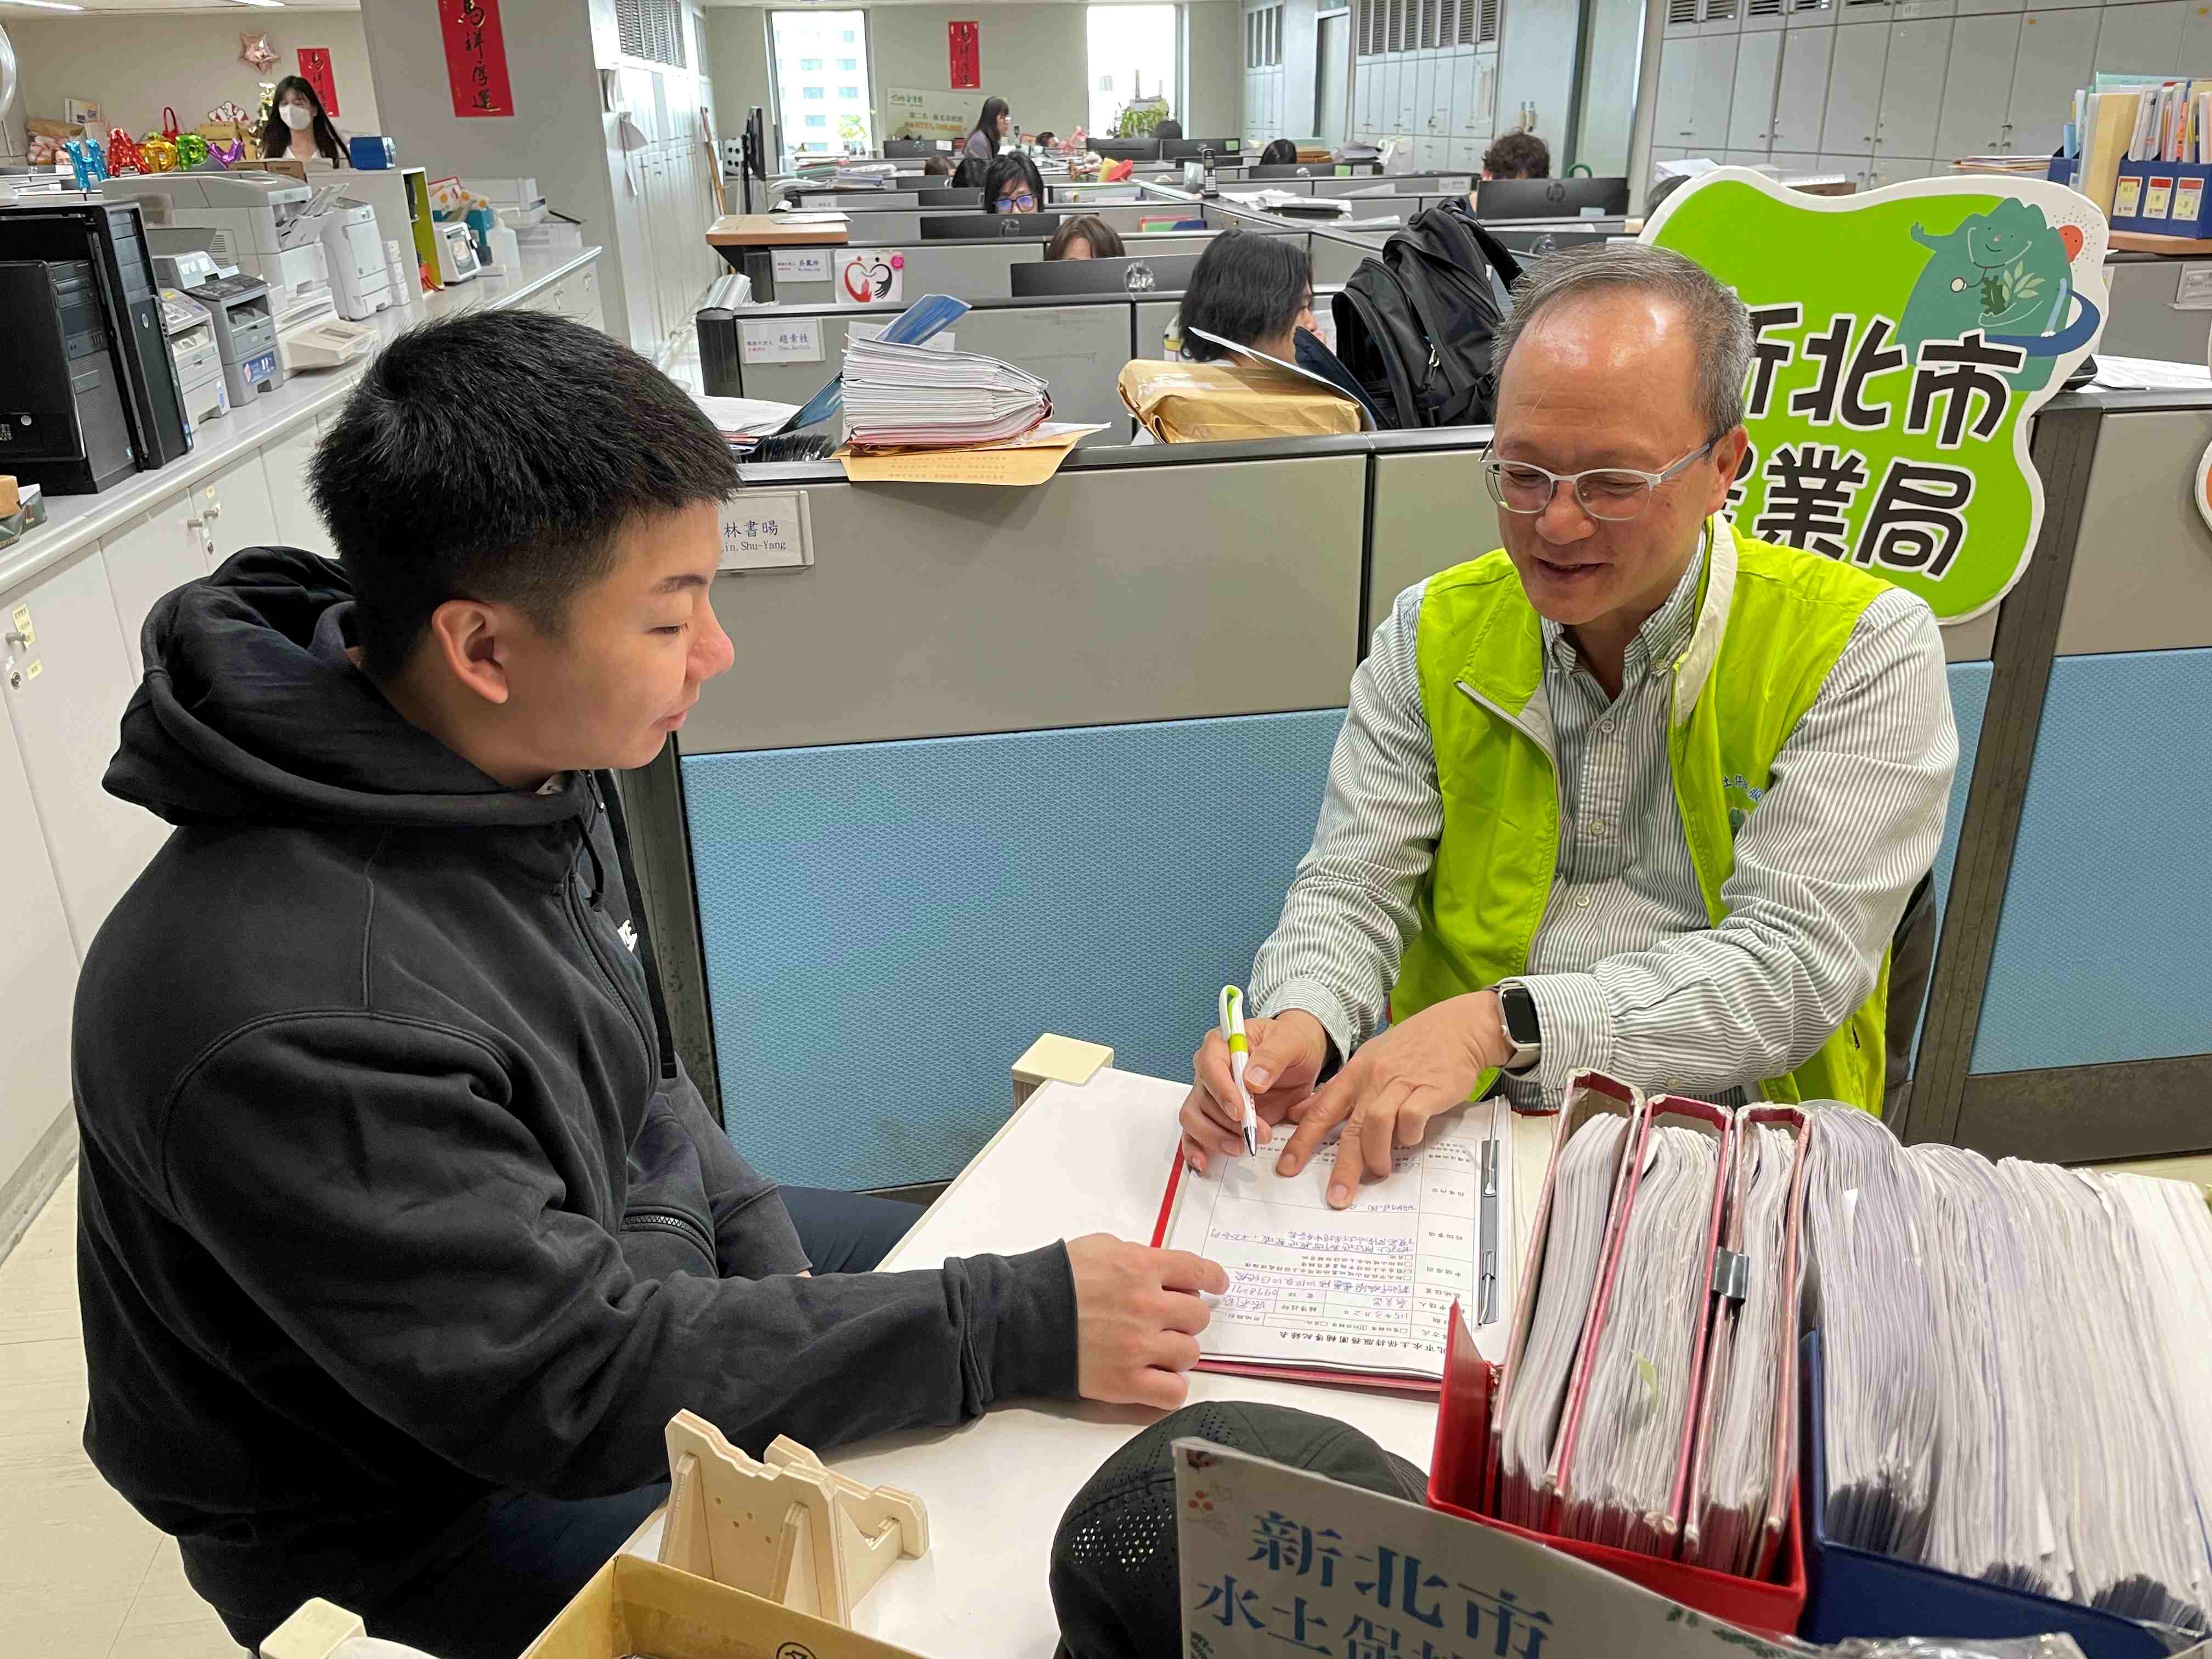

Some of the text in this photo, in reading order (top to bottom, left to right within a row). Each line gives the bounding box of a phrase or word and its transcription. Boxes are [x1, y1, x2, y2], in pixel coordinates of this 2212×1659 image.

[724, 520, 778, 538] 林書暘
[1722, 447, 1972, 576] 業局
[1194, 1575, 1466, 1659] 水土保
[1248, 1510, 1554, 1659] 新北市
